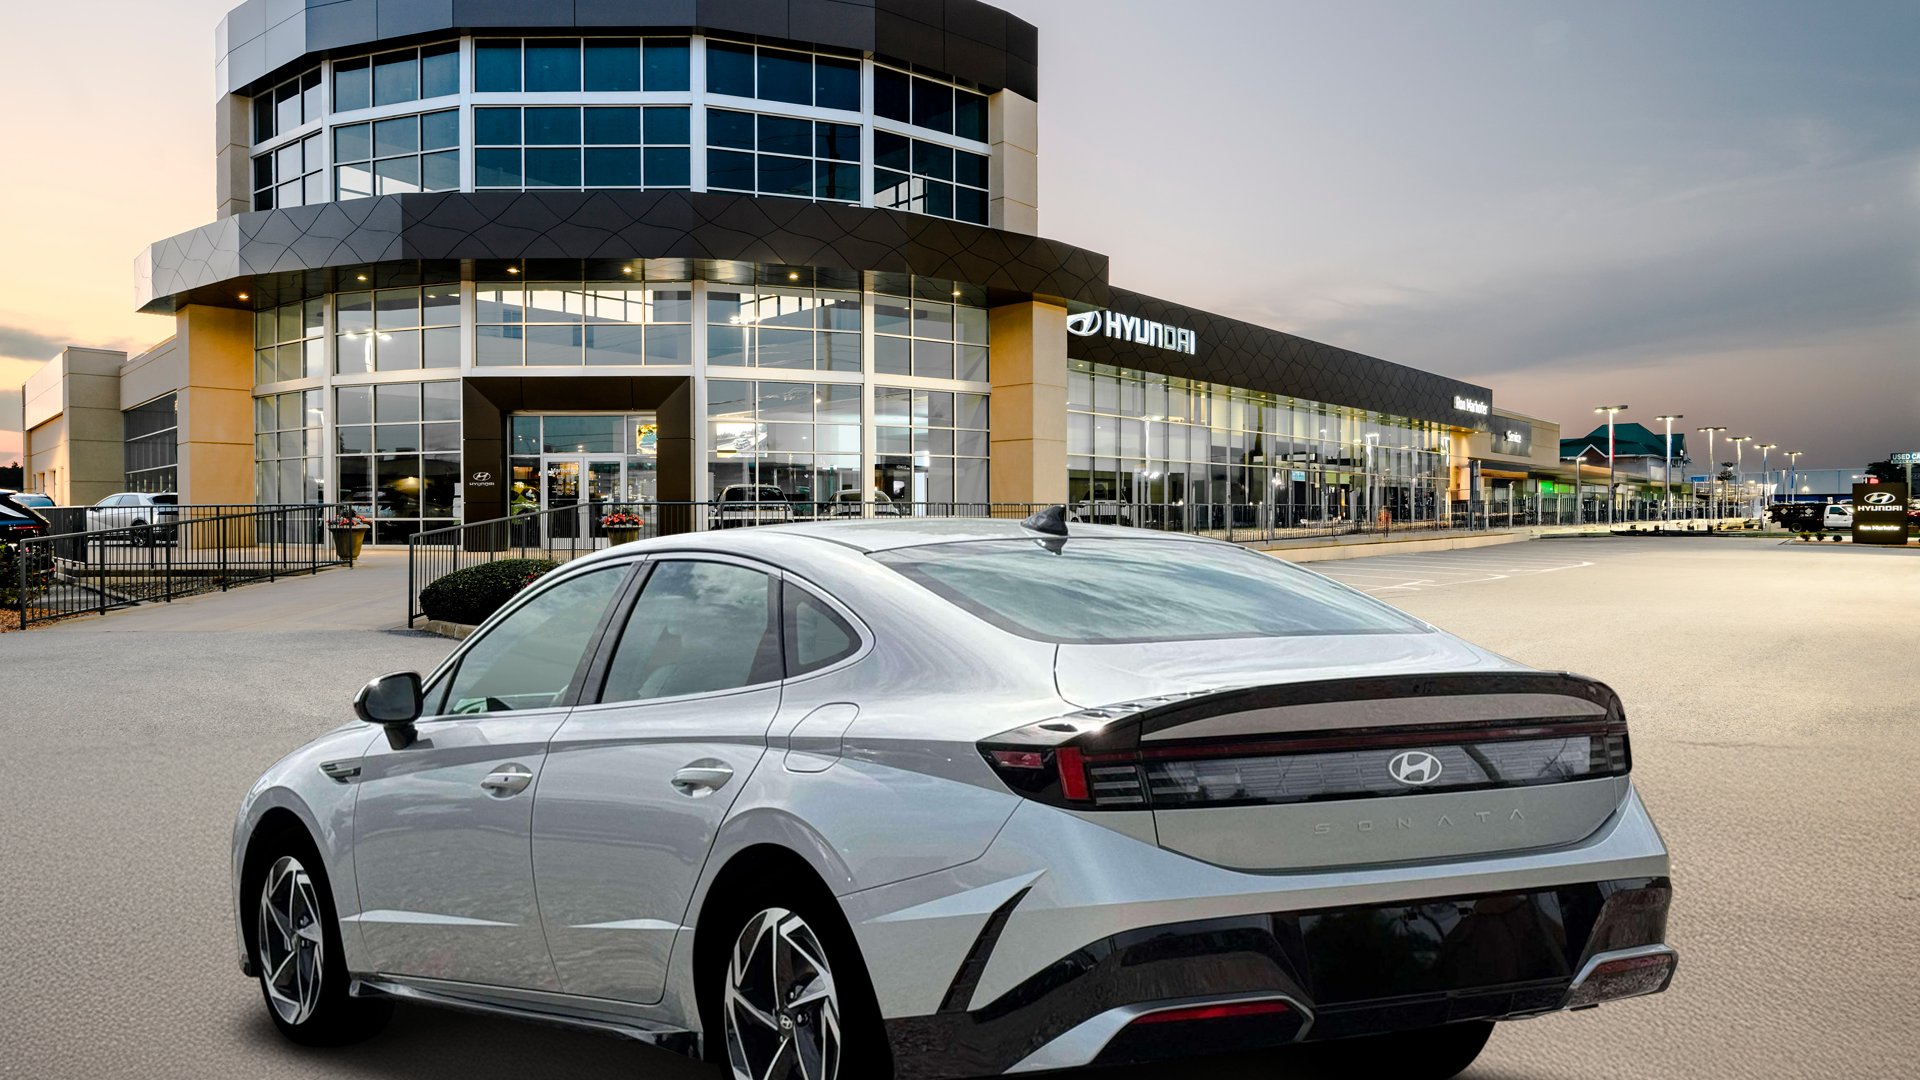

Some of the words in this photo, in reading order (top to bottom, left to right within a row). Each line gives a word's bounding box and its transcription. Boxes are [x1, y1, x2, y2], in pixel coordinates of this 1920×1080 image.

[1104, 310, 1196, 355] HYUNDAI
[1454, 395, 1466, 410] Ron
[1314, 808, 1525, 835] SONATA
